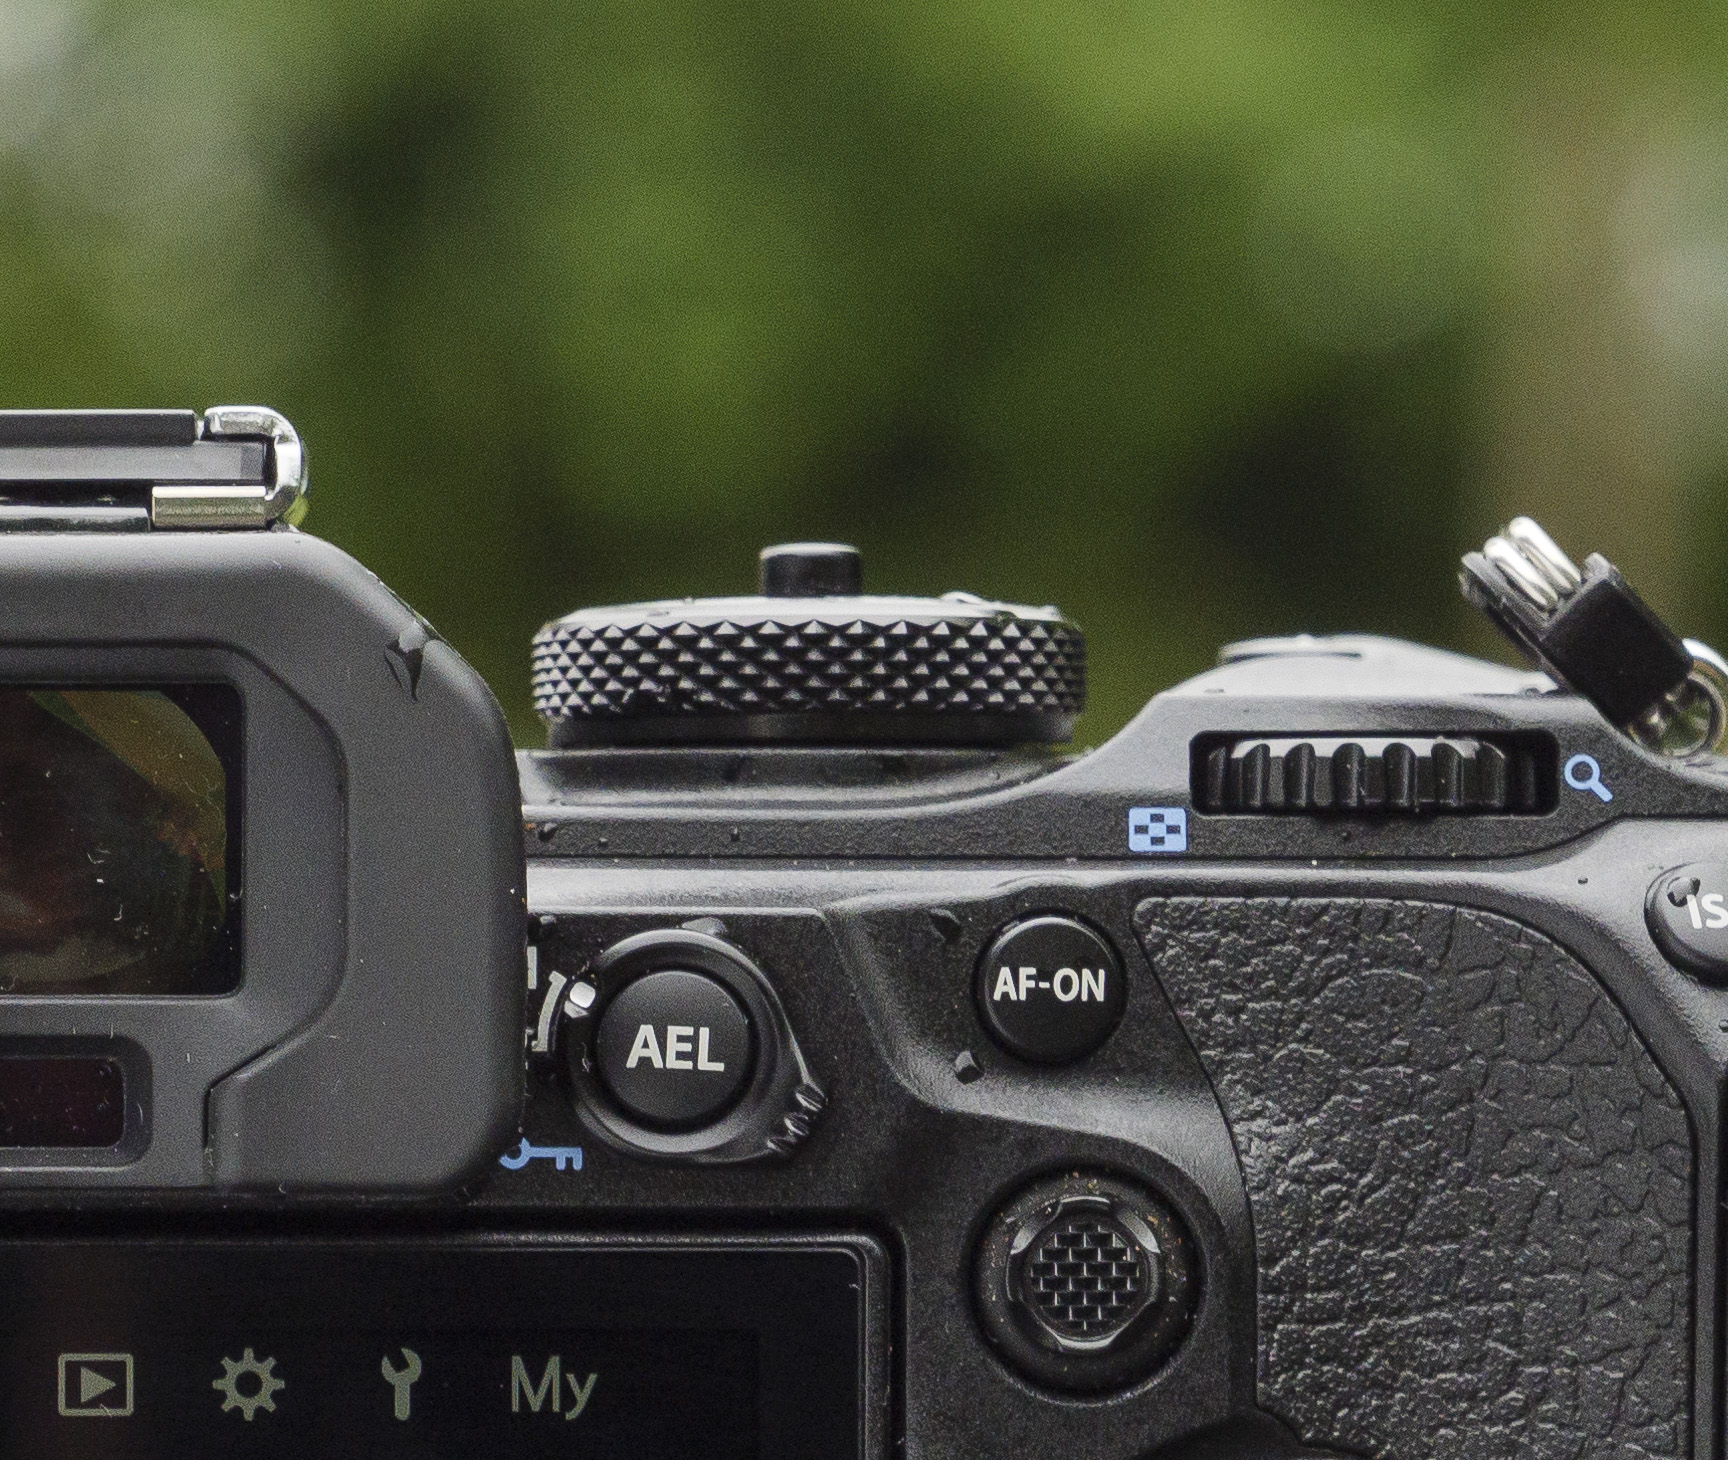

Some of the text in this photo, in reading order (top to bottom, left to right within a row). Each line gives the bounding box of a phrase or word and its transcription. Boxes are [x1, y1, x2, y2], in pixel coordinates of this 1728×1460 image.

[992, 966, 1106, 1003] AF-ON
[625, 1023, 725, 1072] AEL
[510, 1355, 598, 1421] My
